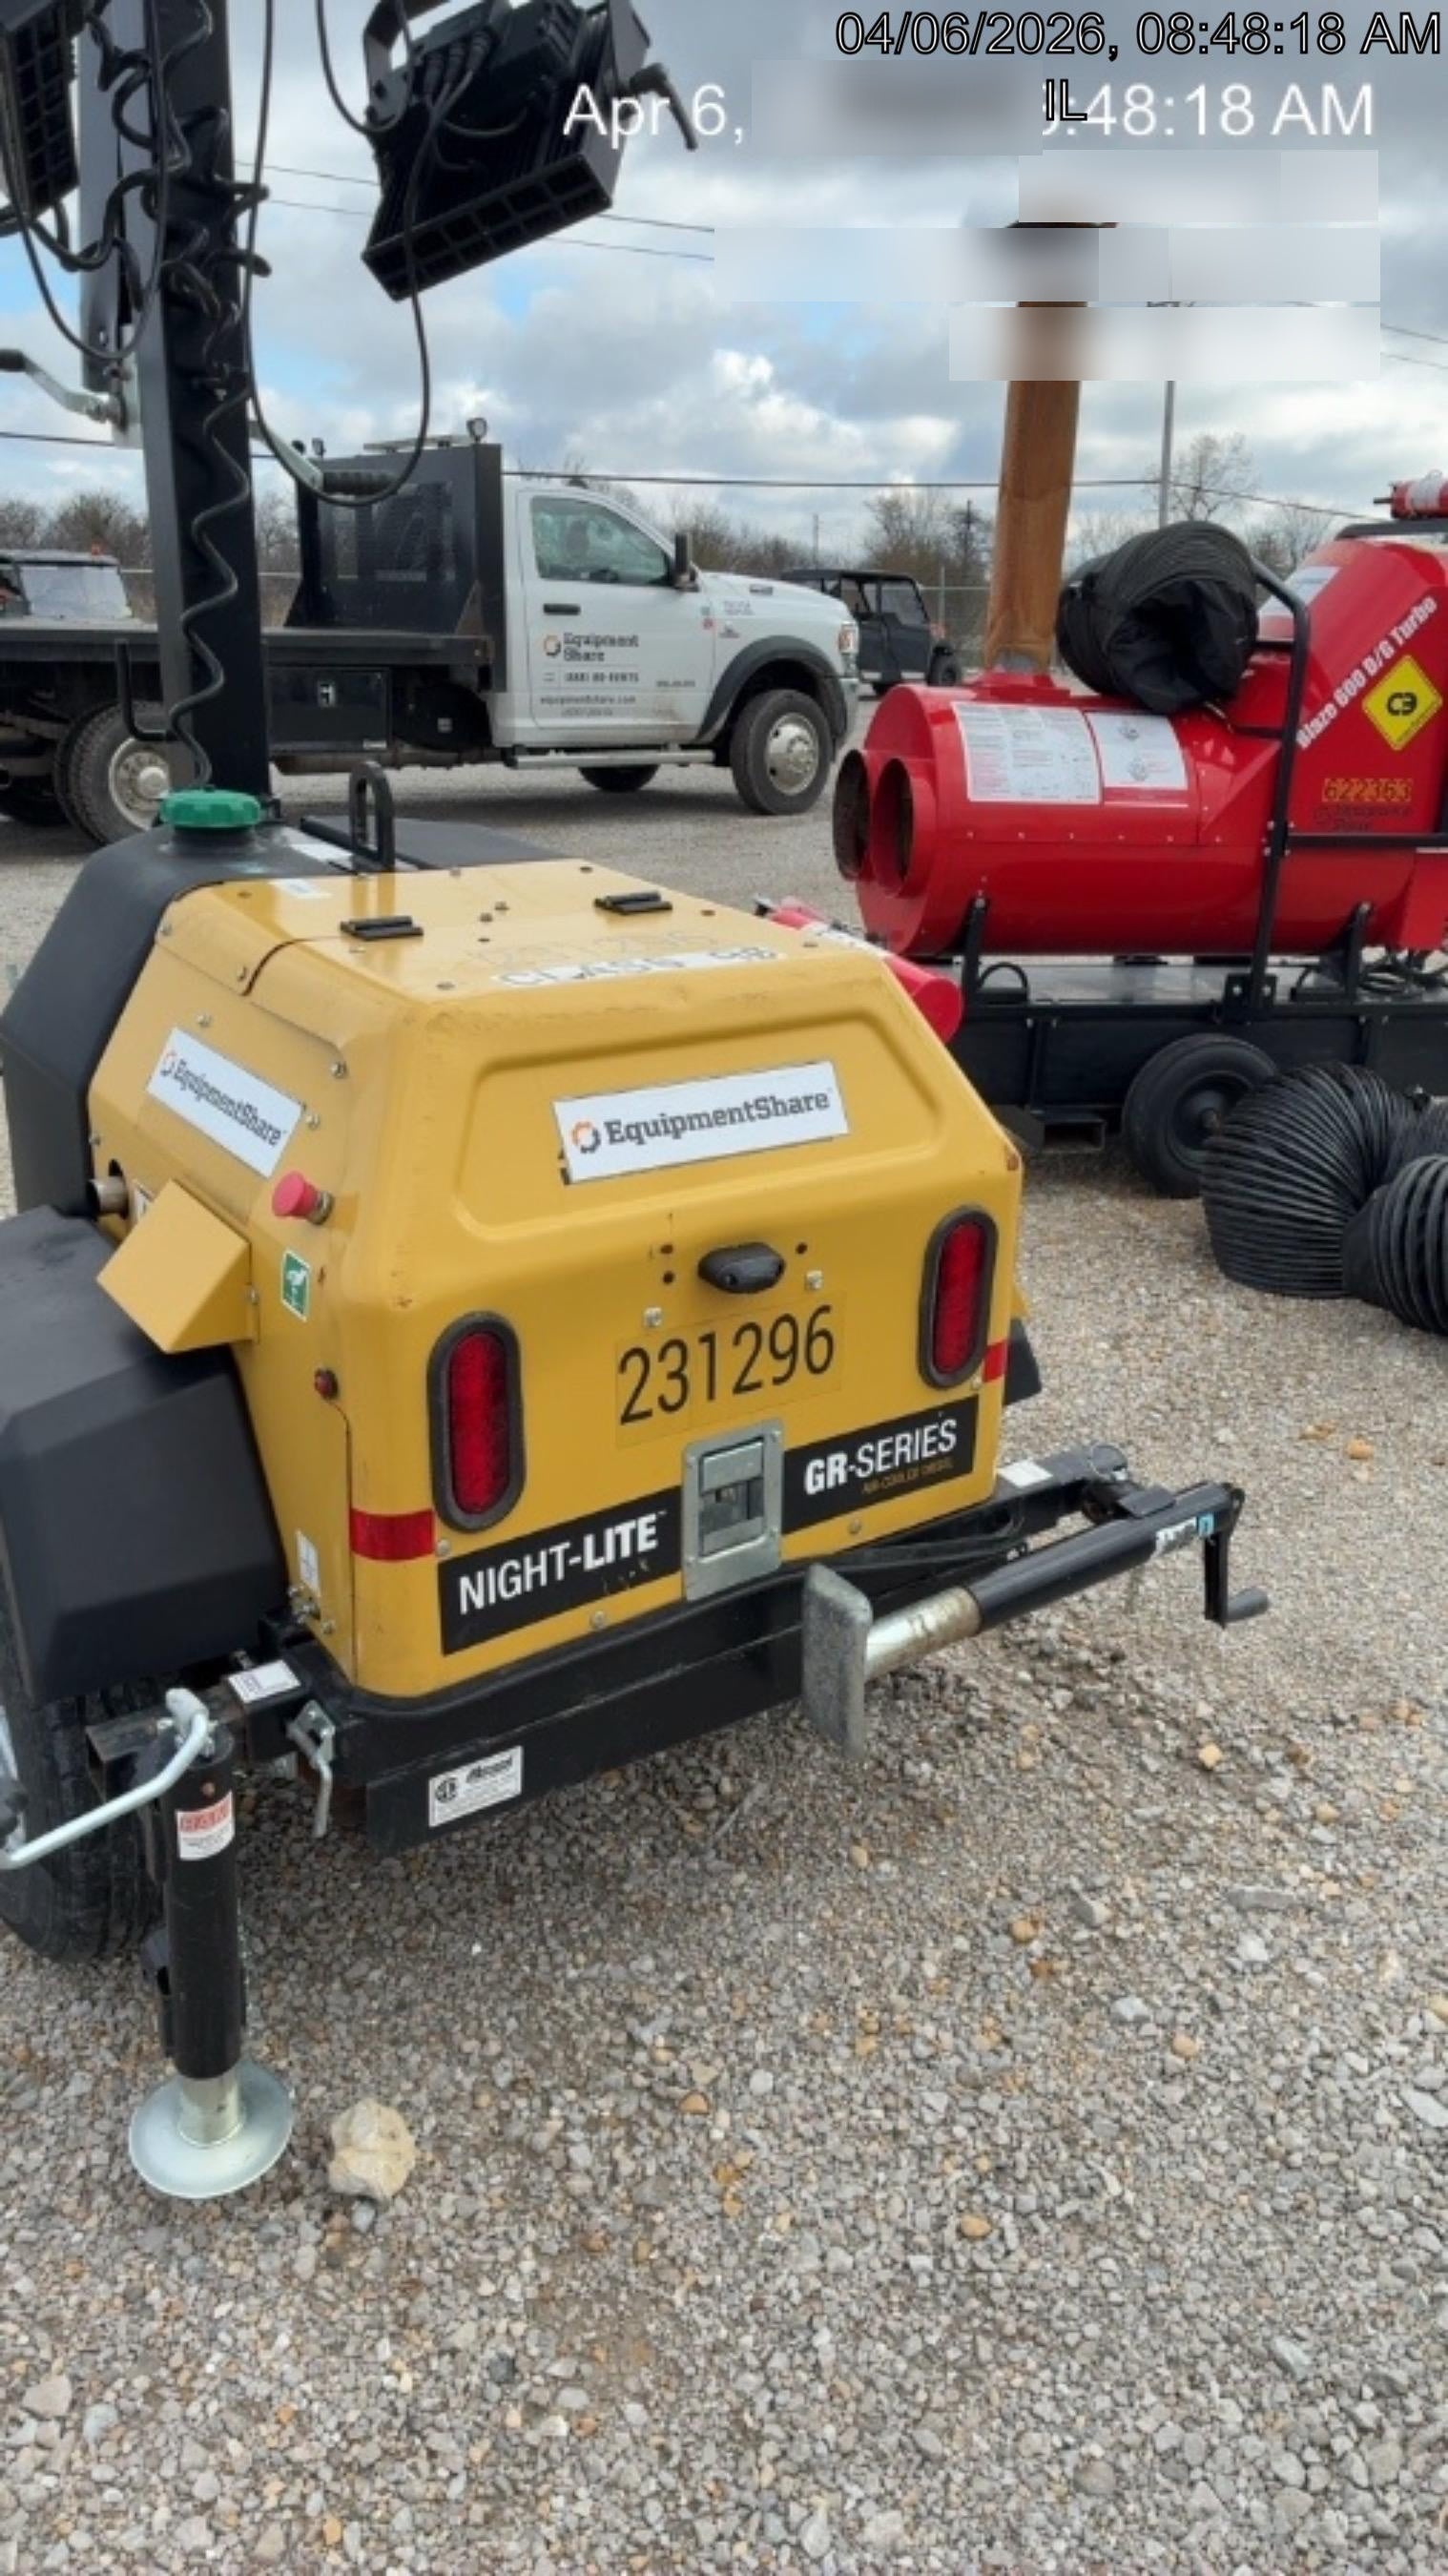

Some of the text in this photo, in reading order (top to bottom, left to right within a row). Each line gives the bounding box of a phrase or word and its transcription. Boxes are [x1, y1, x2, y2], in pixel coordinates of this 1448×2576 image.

[563, 633, 639, 648] Equipment
[1389, 596, 1438, 647] Turbo
[563, 648, 605, 662] Share
[174, 1058, 282, 1148] EquipmentShare
[603, 1091, 830, 1146] EquipmentShare
[618, 1304, 834, 1425] 231296
[804, 1419, 958, 1495] GR-SERIES
